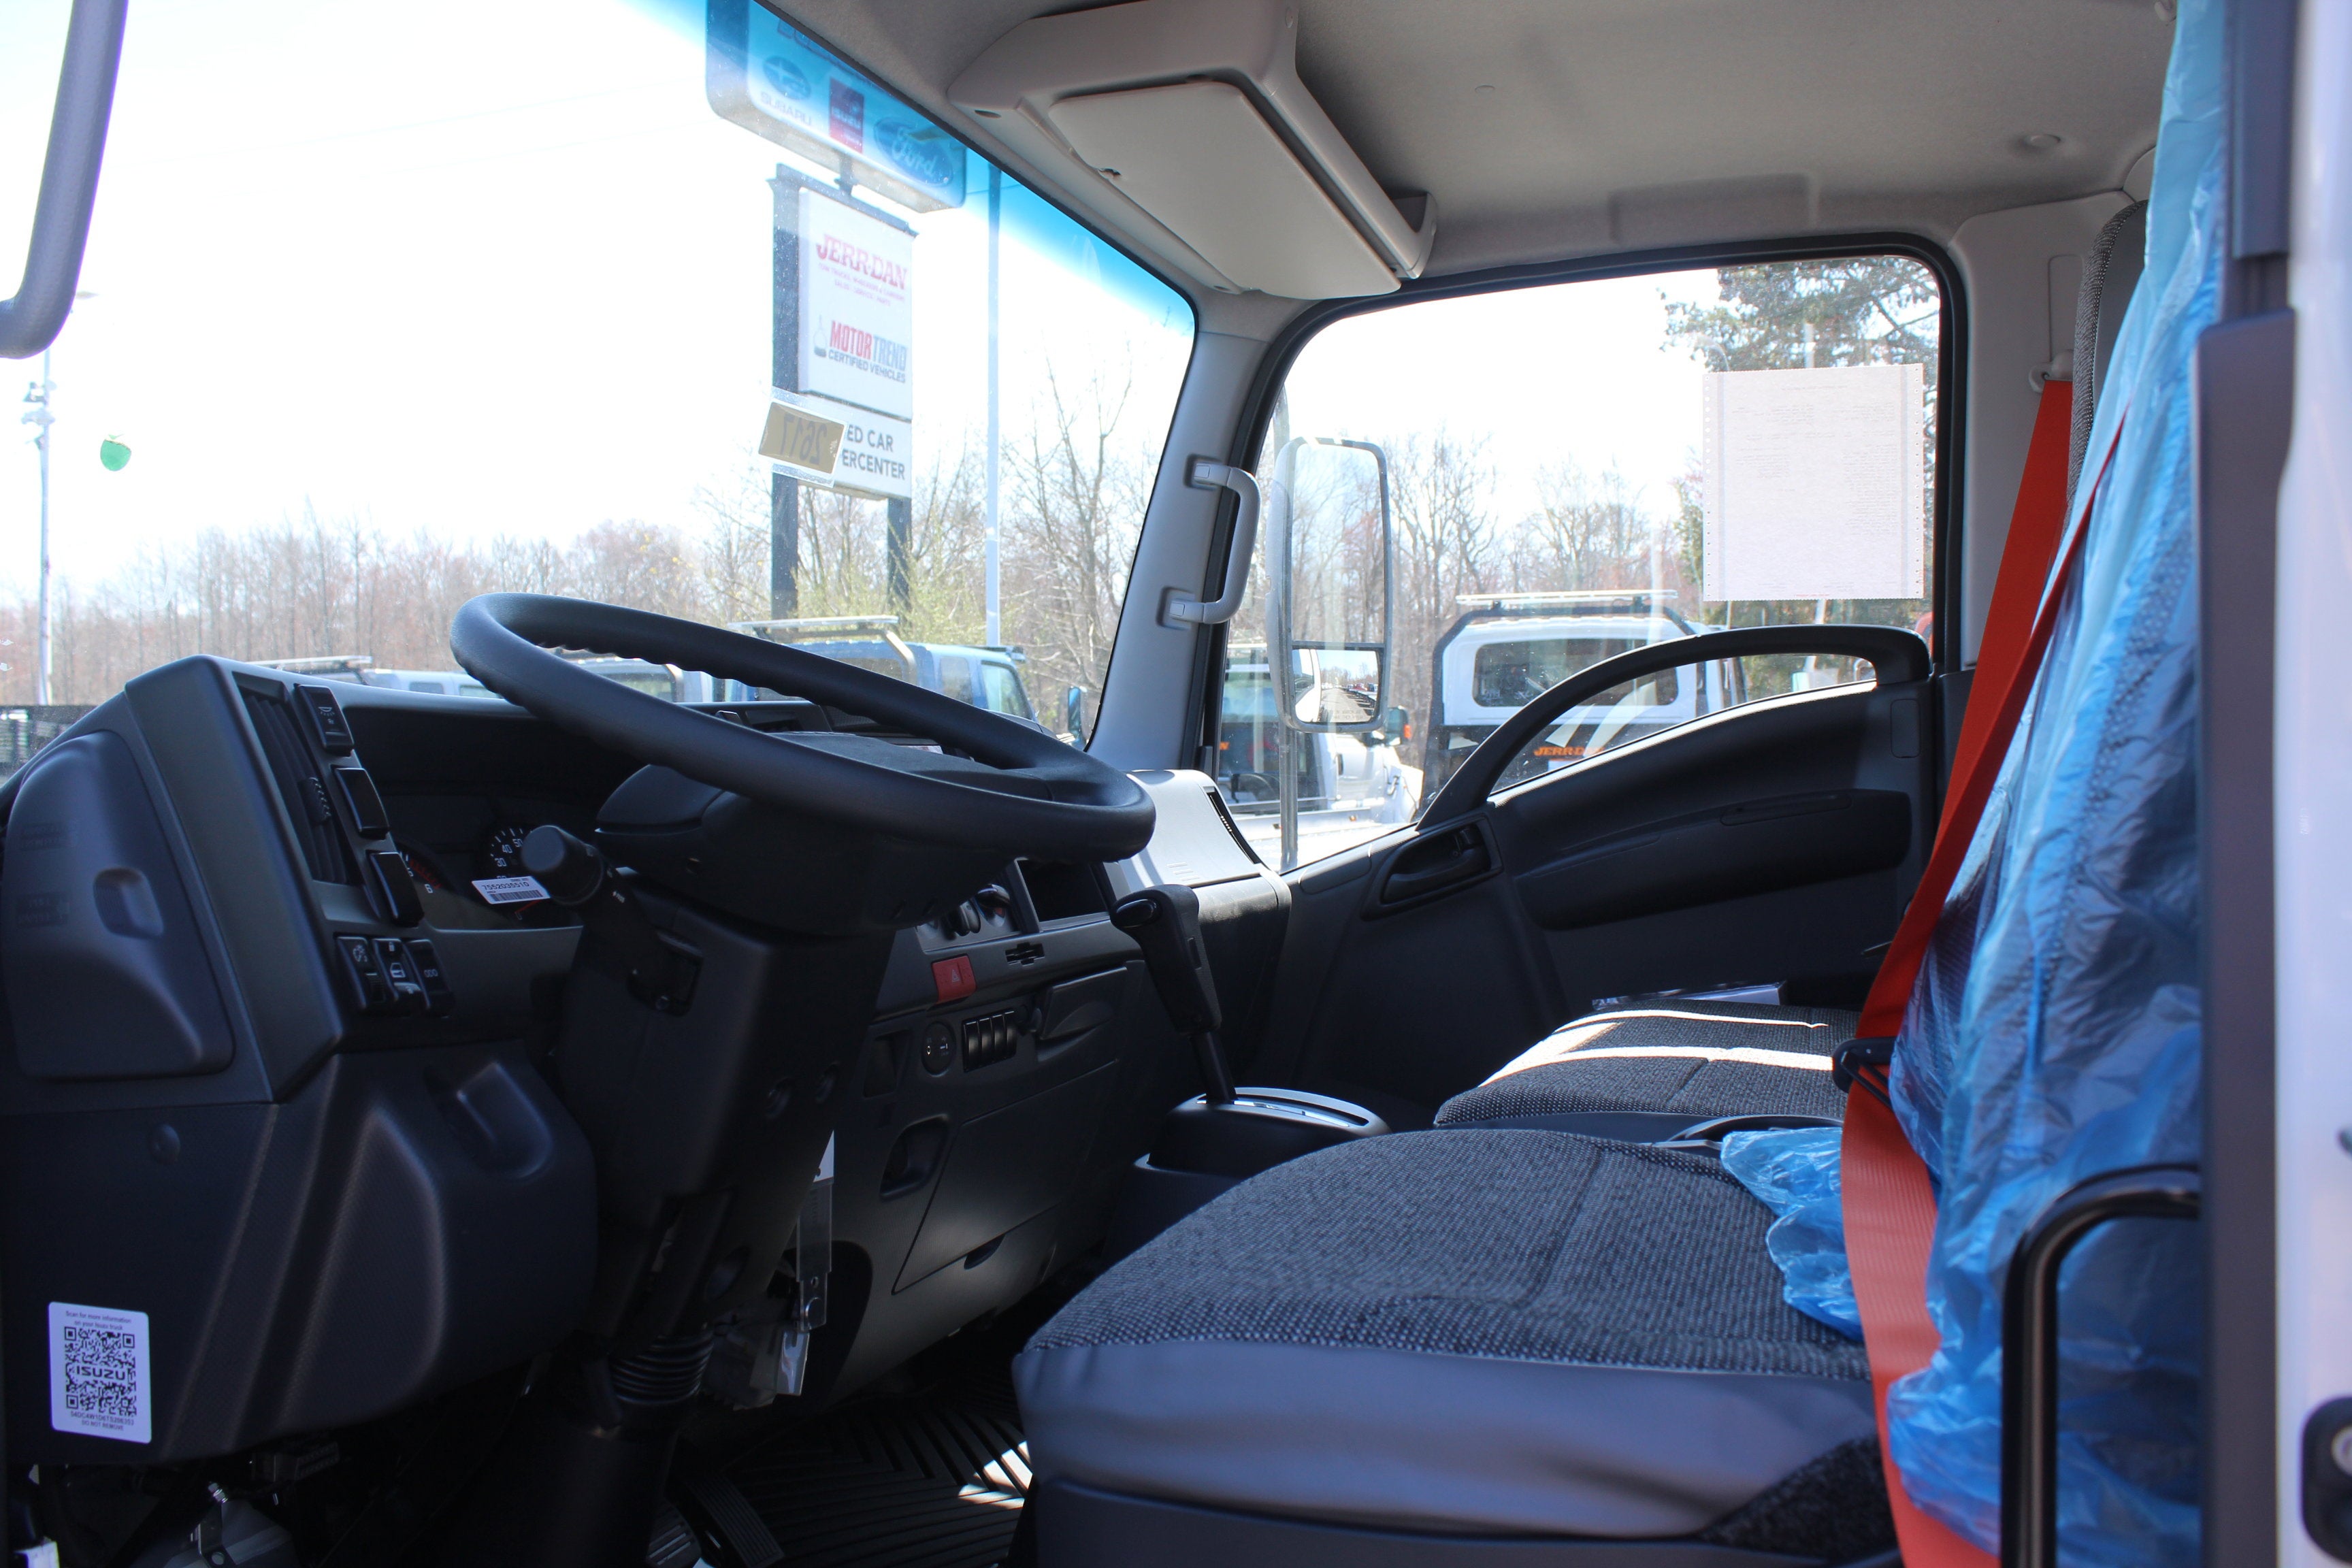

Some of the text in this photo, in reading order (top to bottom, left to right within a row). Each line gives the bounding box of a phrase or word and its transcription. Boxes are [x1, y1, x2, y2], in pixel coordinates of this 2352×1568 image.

[760, 91, 812, 125] SUBARU
[892, 127, 938, 178] Ford
[828, 349, 906, 384] CERTIFIED VEHICLES
[847, 423, 894, 452] ED CAR
[841, 449, 906, 480] ERCENTER
[1533, 746, 1604, 757] JERR-D
[512, 838, 523, 847] 50
[502, 845, 512, 854] 40
[494, 858, 507, 867] 30
[424, 883, 434, 894] 6
[481, 881, 529, 891] 7552035510
[102, 1315, 132, 1324] information
[76, 1365, 126, 1381] ISUZU
[91, 1420, 101, 1428] NOT
[102, 1422, 125, 1431] REMOVE
